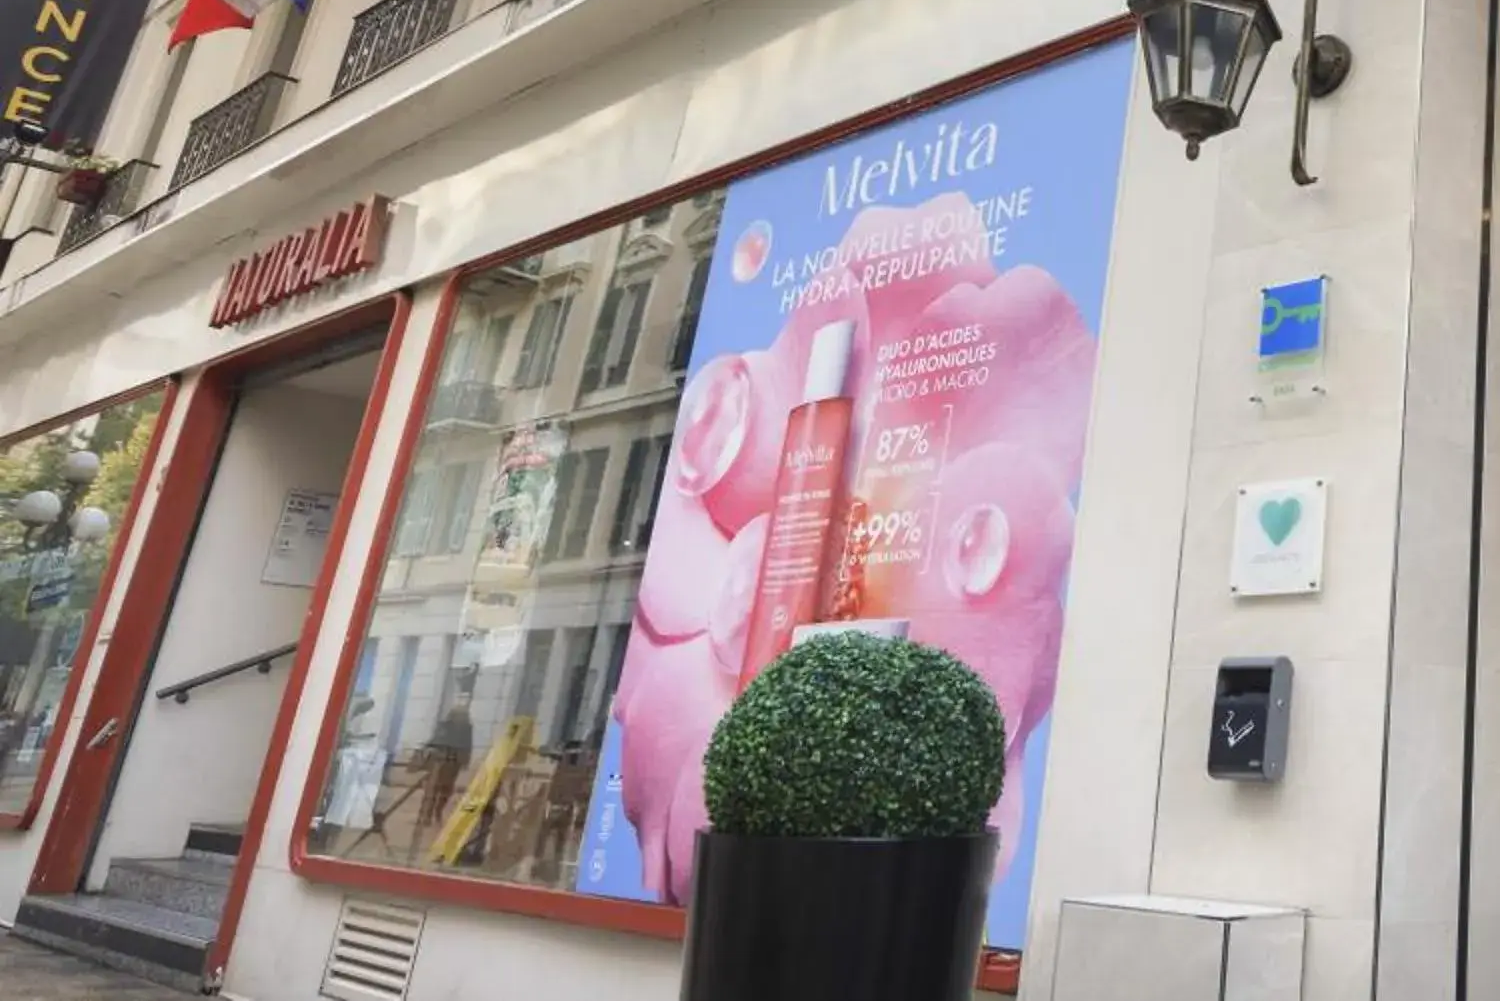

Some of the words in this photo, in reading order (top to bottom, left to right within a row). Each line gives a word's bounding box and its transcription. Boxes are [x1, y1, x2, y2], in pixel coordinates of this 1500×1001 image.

[817, 120, 998, 221] Melvita
[209, 193, 390, 328] NATURALIA
[772, 260, 795, 288] LA
[803, 224, 914, 277] NOUVELLE
[921, 187, 1033, 242] ROUTINE
[876, 340, 911, 362] DUO
[876, 423, 929, 463] 87%
